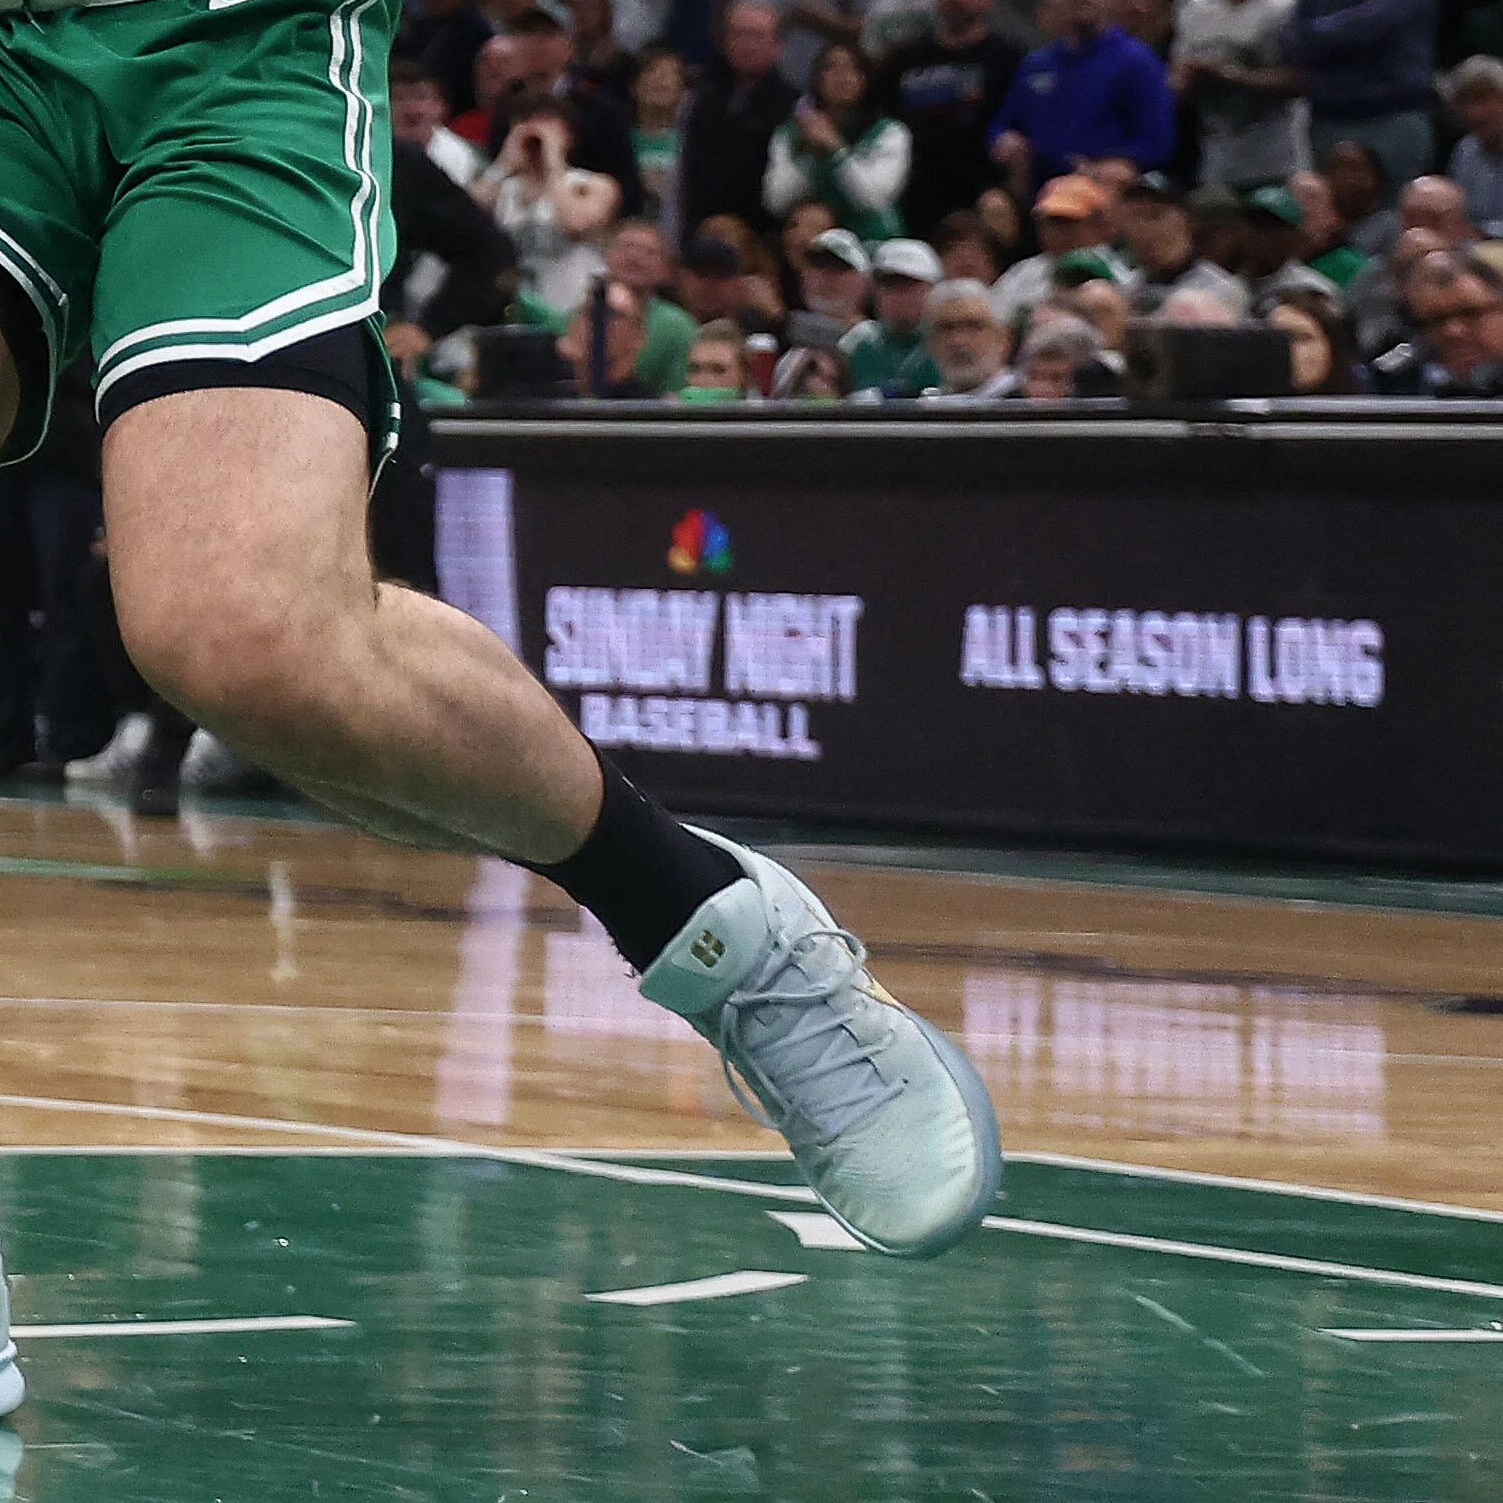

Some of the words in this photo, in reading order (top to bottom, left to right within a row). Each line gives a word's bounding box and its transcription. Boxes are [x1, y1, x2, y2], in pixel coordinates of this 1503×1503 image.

[959, 604, 1044, 691] ALL
[1047, 606, 1241, 698] SEASON
[1246, 614, 1385, 708] LONG
